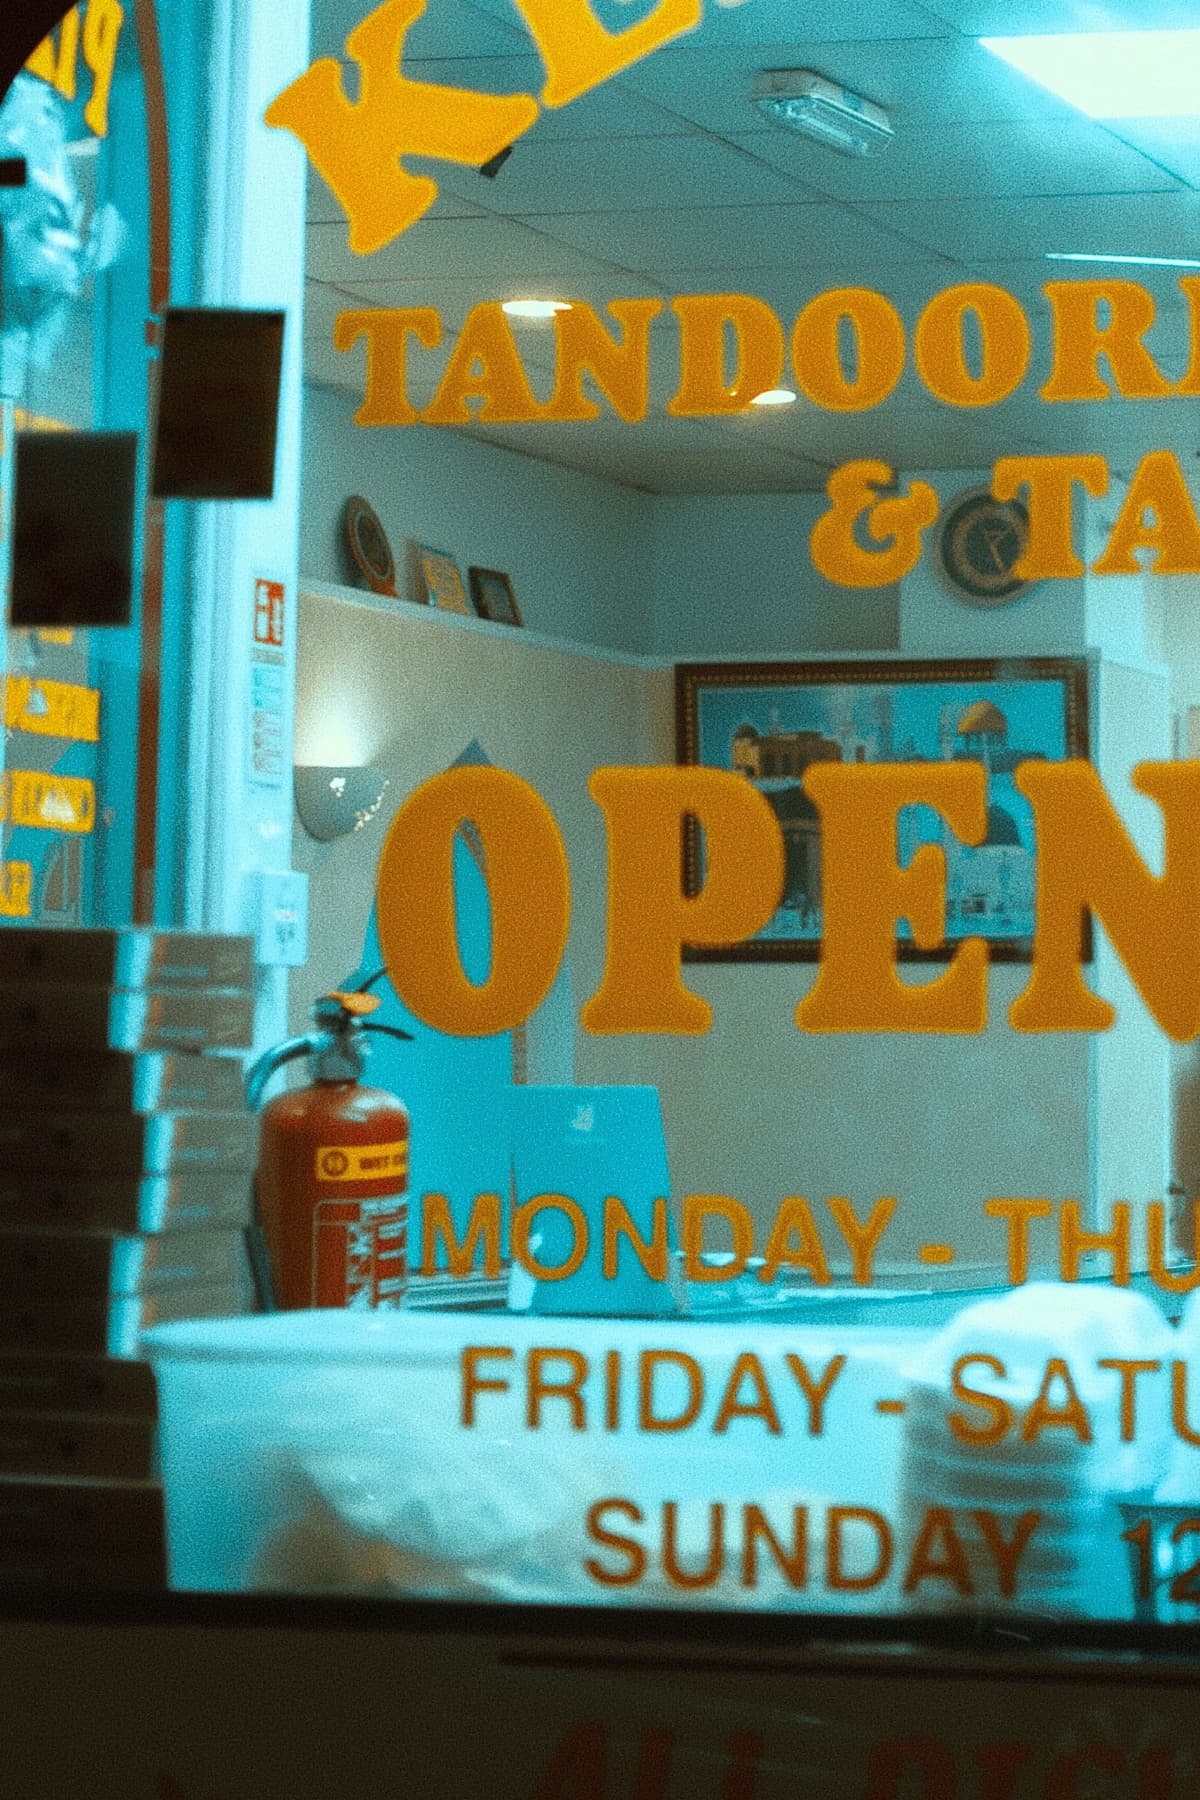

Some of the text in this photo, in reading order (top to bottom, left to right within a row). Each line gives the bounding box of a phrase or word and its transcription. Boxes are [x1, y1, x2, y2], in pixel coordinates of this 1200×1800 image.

[264, 0, 750, 254] KE
[809, 458, 938, 588] &
[418, 1192, 897, 1285] MONDAY
[461, 1346, 847, 1438] FRIDAY
[583, 1497, 1042, 1596] SUNDAY
